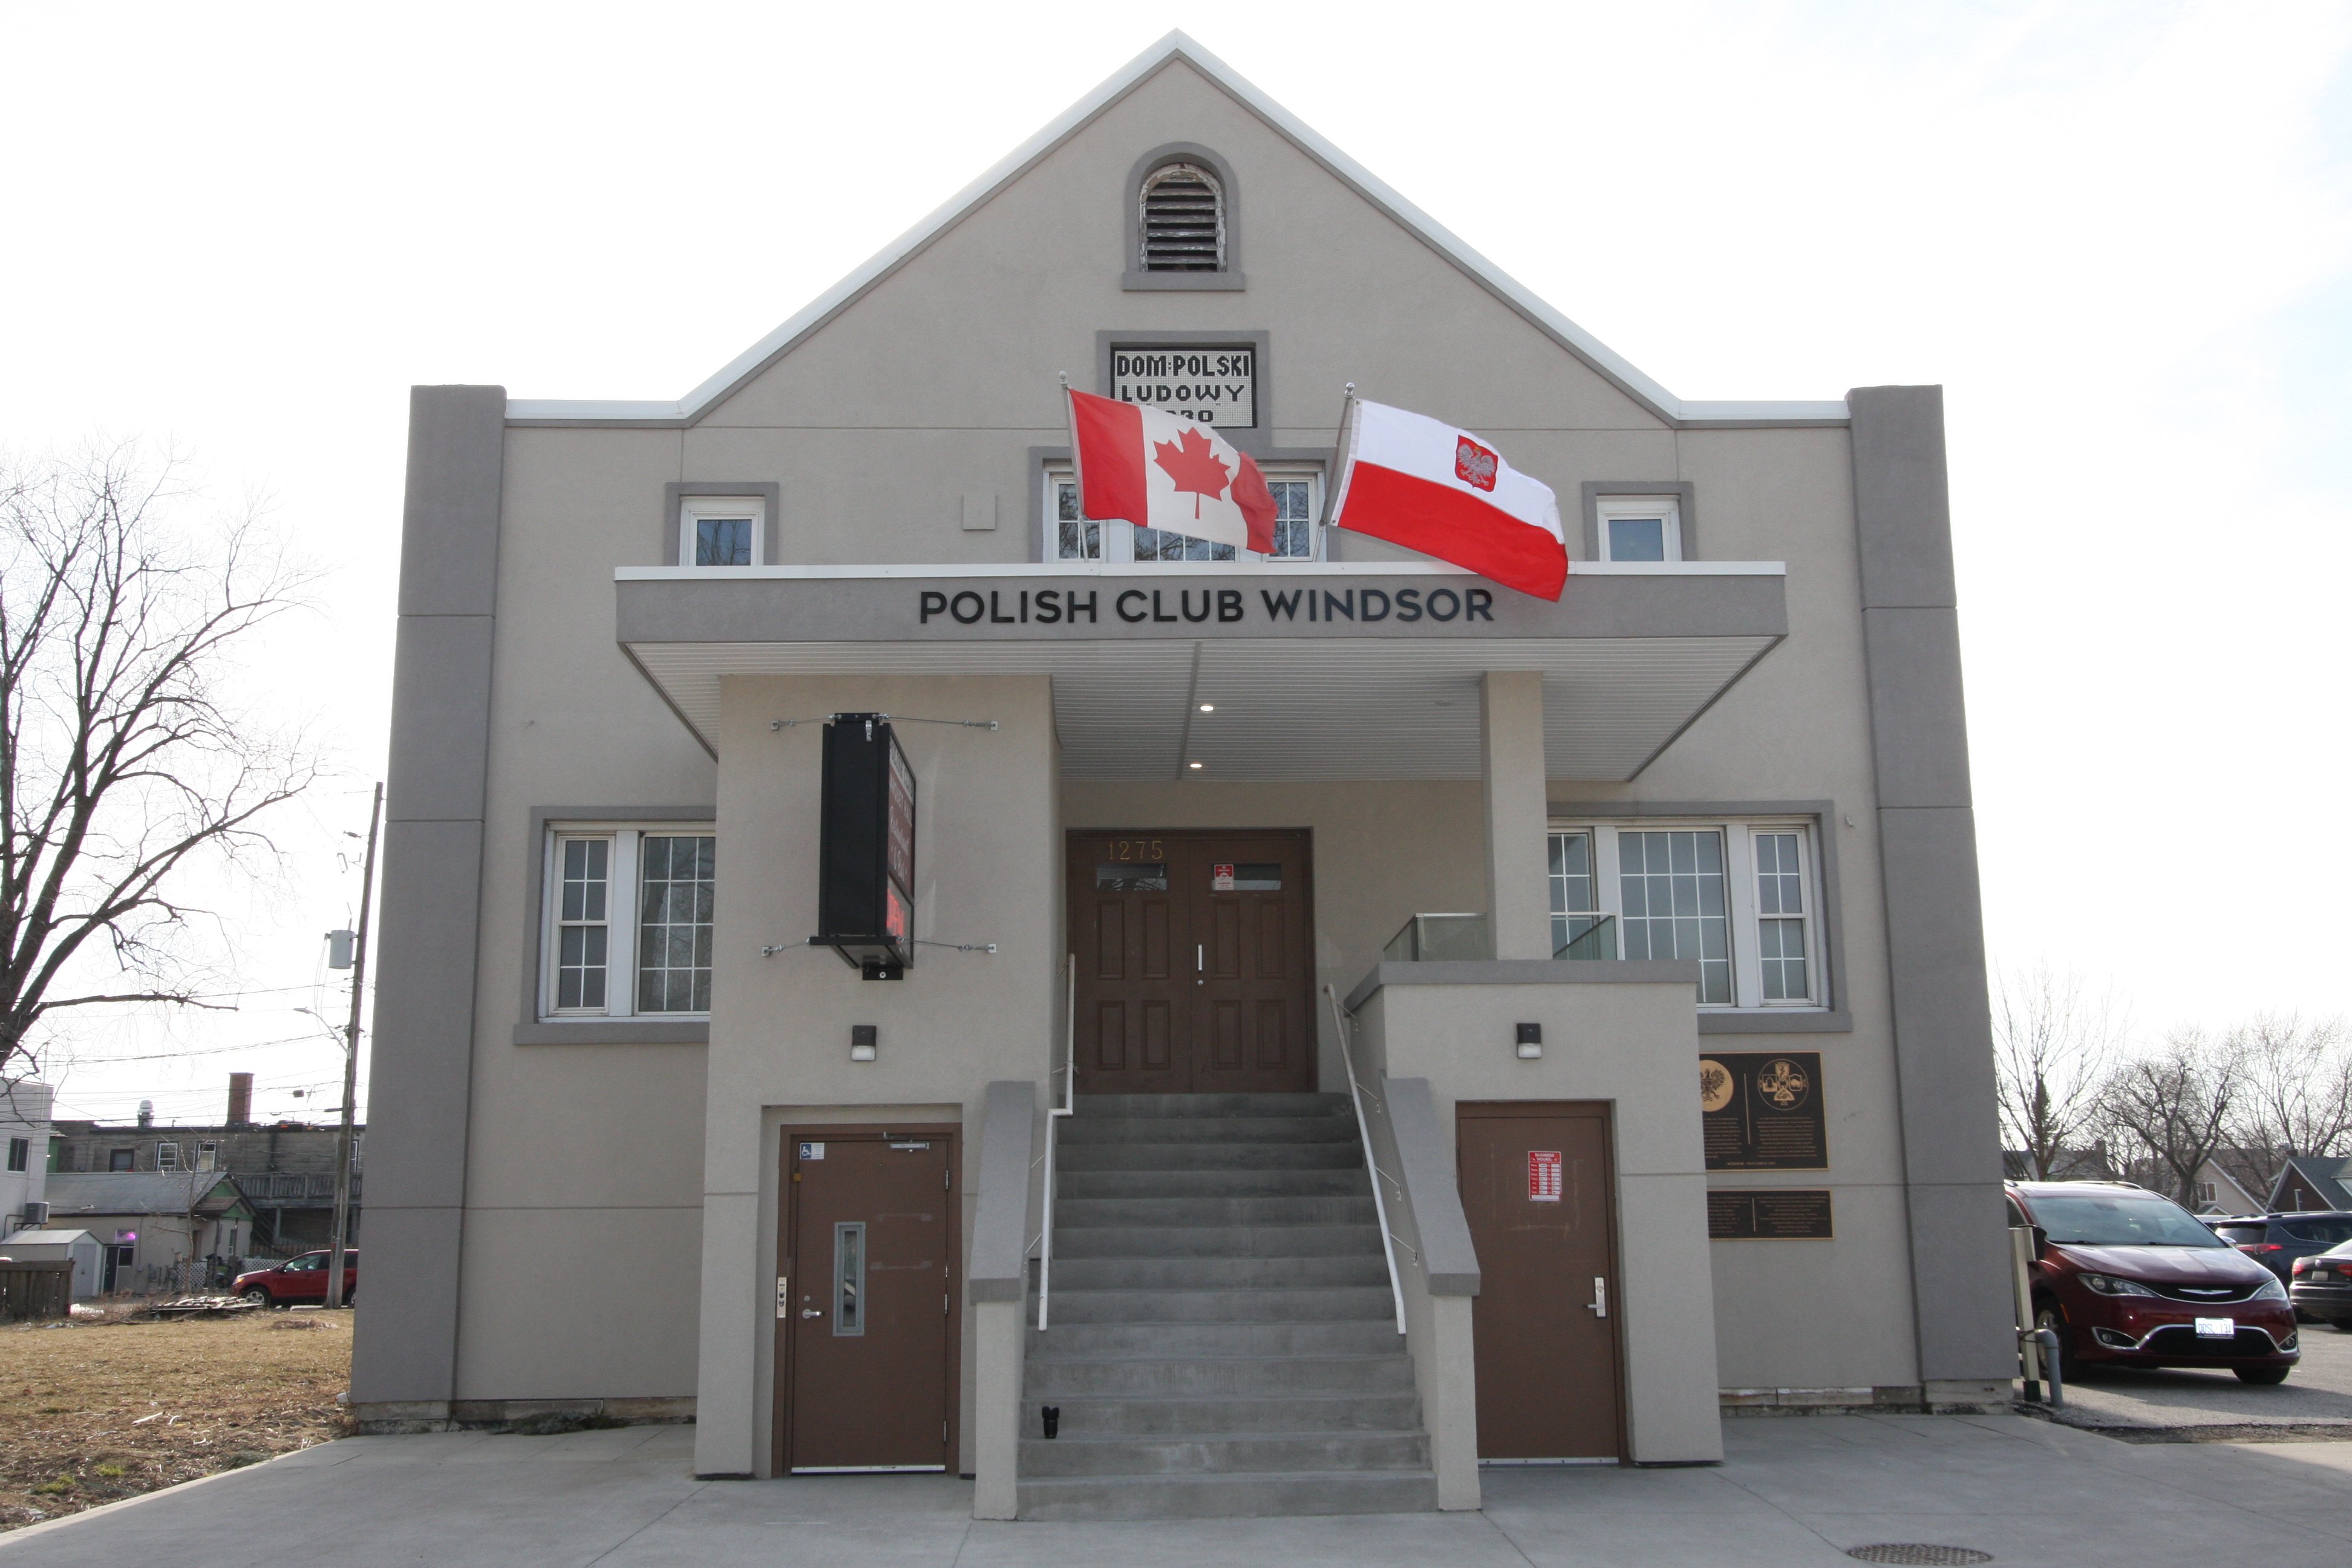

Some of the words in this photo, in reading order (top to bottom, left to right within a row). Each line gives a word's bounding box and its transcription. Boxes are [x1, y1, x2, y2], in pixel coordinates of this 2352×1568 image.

[1122, 385, 1245, 402] LUDOWY
[920, 590, 1097, 624] POLISH
[1116, 589, 1244, 622] CLUB
[1260, 588, 1495, 622] WINDSOR
[1108, 840, 1163, 860] 1275
